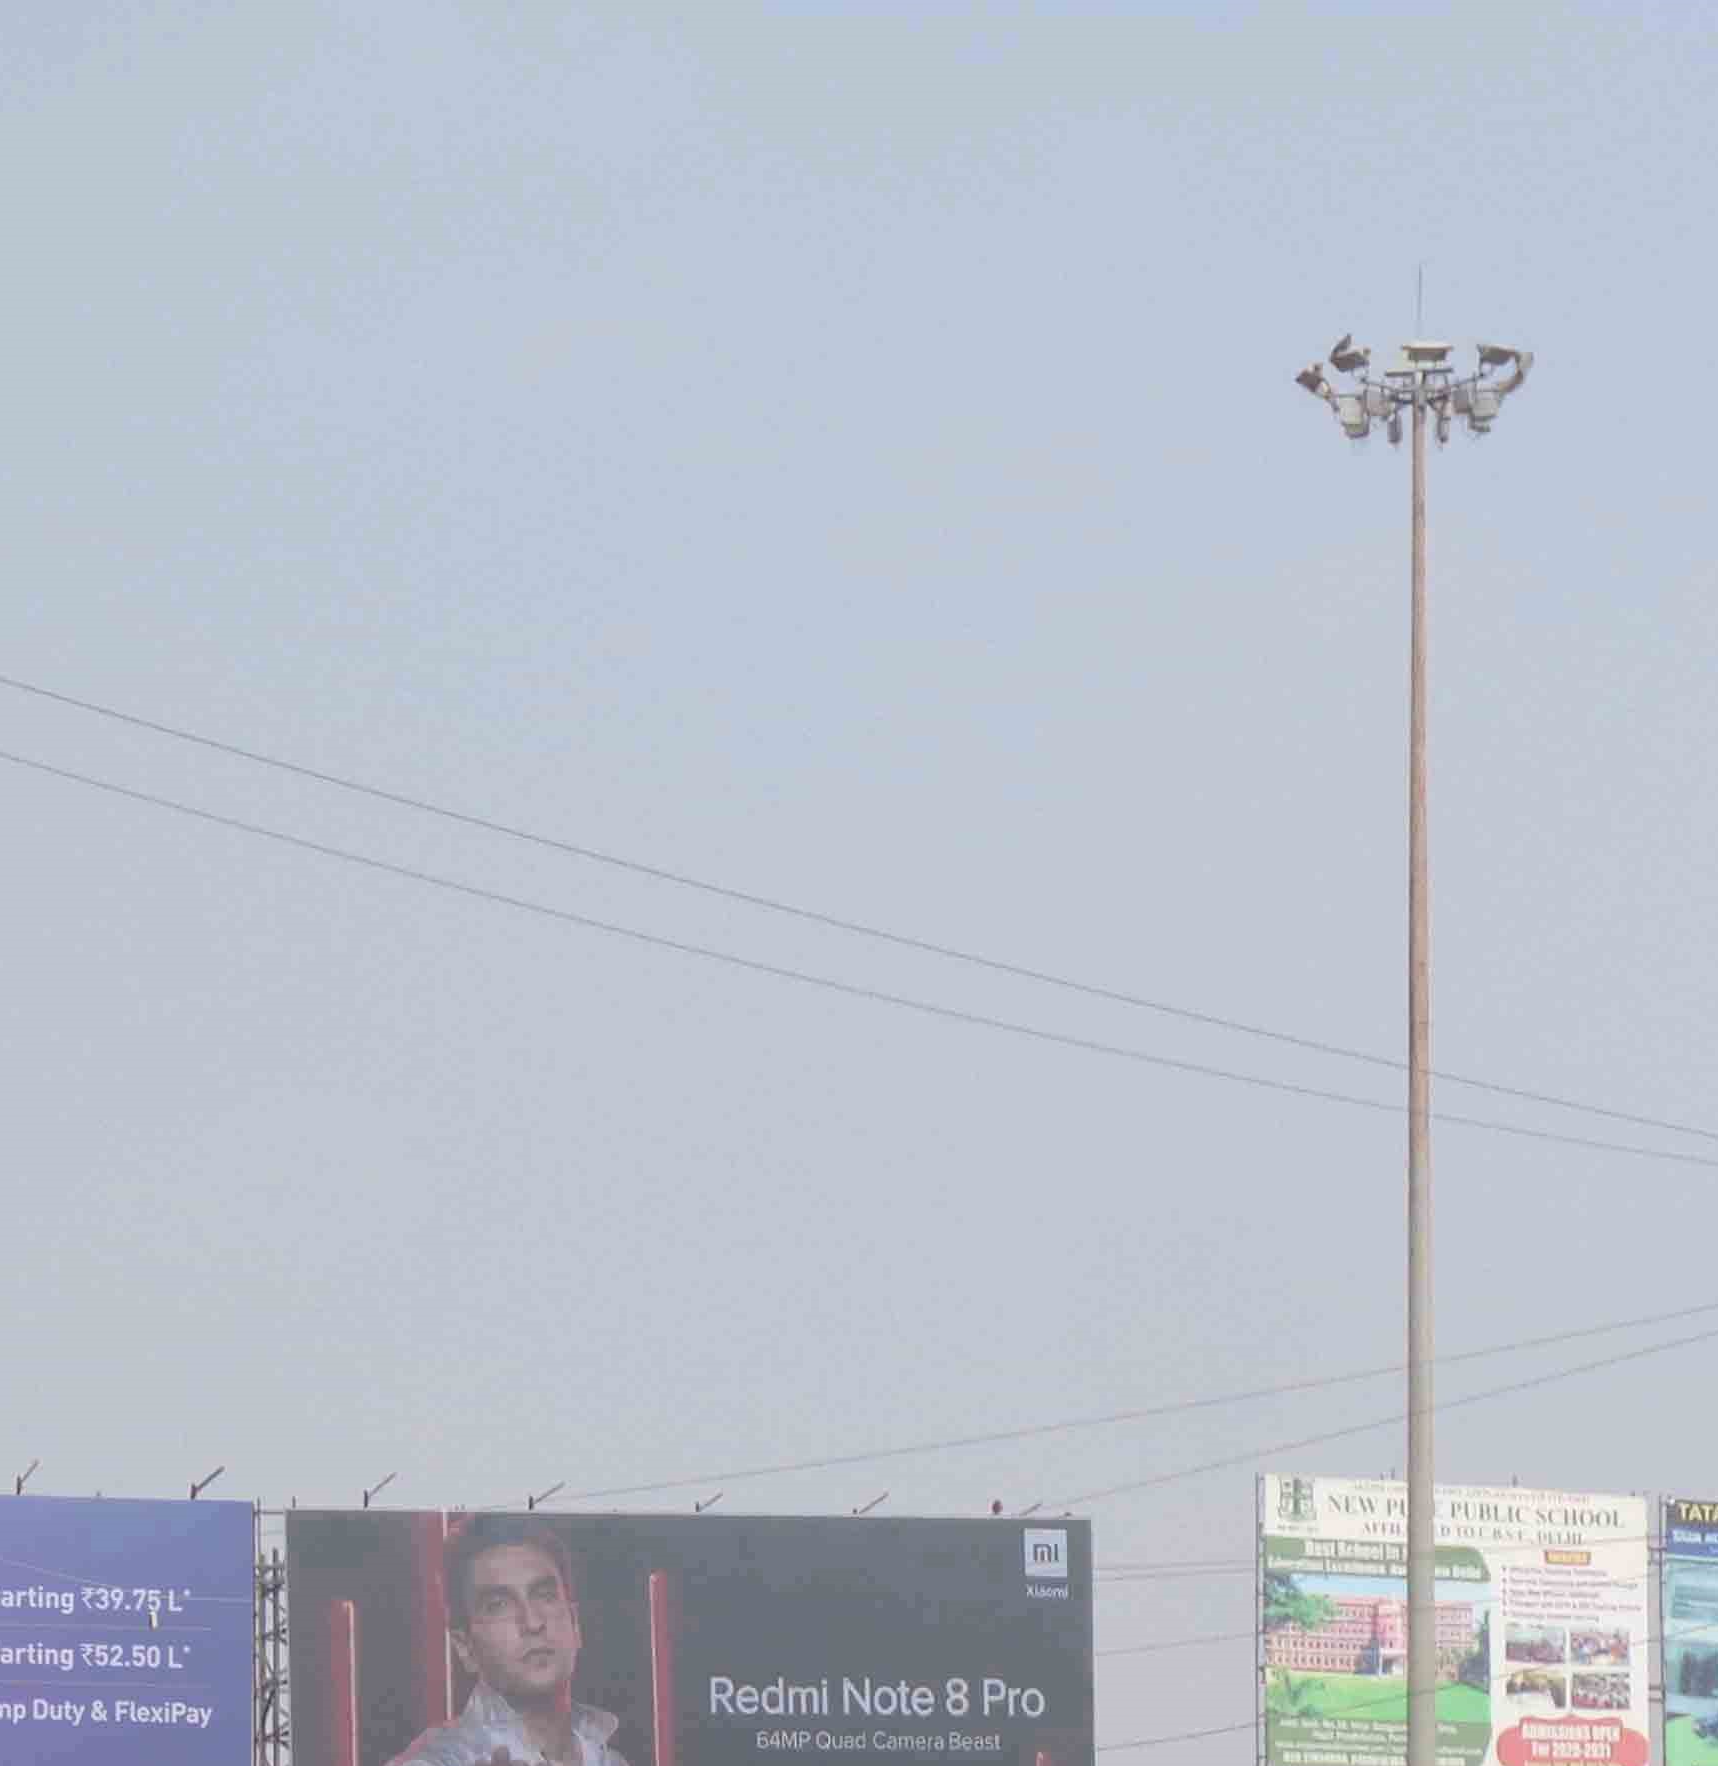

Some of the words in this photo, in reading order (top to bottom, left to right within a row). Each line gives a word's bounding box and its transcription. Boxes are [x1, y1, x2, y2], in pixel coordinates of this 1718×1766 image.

[1329, 1495, 1377, 1516] NEW
[1450, 1500, 1527, 1525] PUBLIC
[1534, 1504, 1626, 1531] SCHOOL
[80, 1643, 161, 1668] ₹52.50
[709, 1676, 829, 1716] Redmi
[843, 1676, 935, 1717] Note
[945, 1678, 970, 1717] 8
[982, 1678, 1046, 1718] Pro
[33, 1698, 84, 1726] Duty
[90, 1700, 107, 1722] &
[115, 1700, 213, 1729] FlexiPay
[756, 1731, 811, 1750] 64MP
[816, 1731, 867, 1751] Quad
[872, 1732, 944, 1751] Camera
[949, 1733, 1001, 1751] Beast
